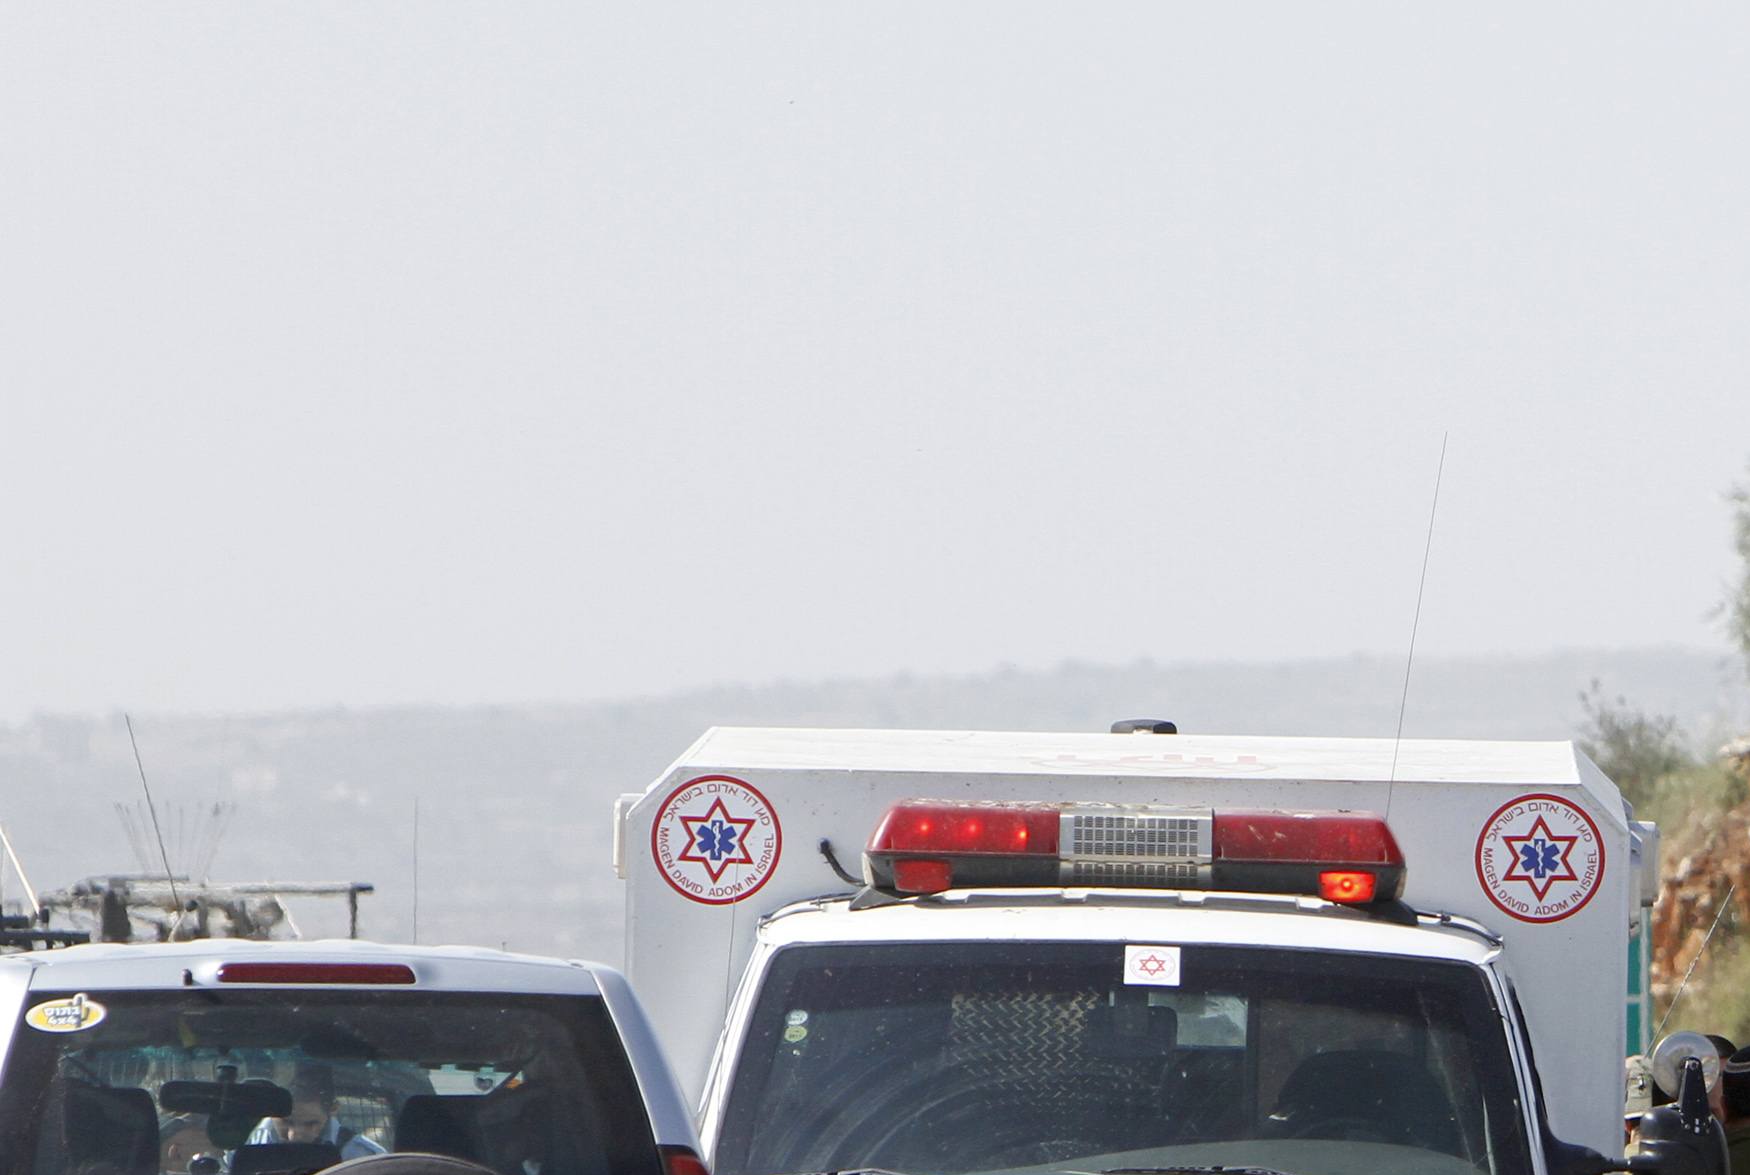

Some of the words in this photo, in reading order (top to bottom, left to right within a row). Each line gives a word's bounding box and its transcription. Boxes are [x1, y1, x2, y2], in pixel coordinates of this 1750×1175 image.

[707, 784, 739, 796] אדום
[742, 791, 758, 807] דוד
[663, 786, 703, 822] בישראל
[1528, 802, 1559, 814] אדום
[755, 808, 770, 826] מגן
[1486, 806, 1525, 842] בישראל
[1563, 808, 1580, 824] דוד
[1576, 824, 1593, 843] מגן
[659, 827, 675, 869] MAGEN
[672, 870, 703, 894] DAVID
[708, 883, 743, 897] ADOM
[746, 873, 757, 887] IN
[755, 833, 774, 875] ISRAEL
[1484, 847, 1500, 890] MAGEN
[1497, 889, 1529, 913] DAVID
[1534, 900, 1569, 915] ADOM
[1570, 890, 1583, 903] IN
[1580, 849, 1597, 892] ISRAEL
